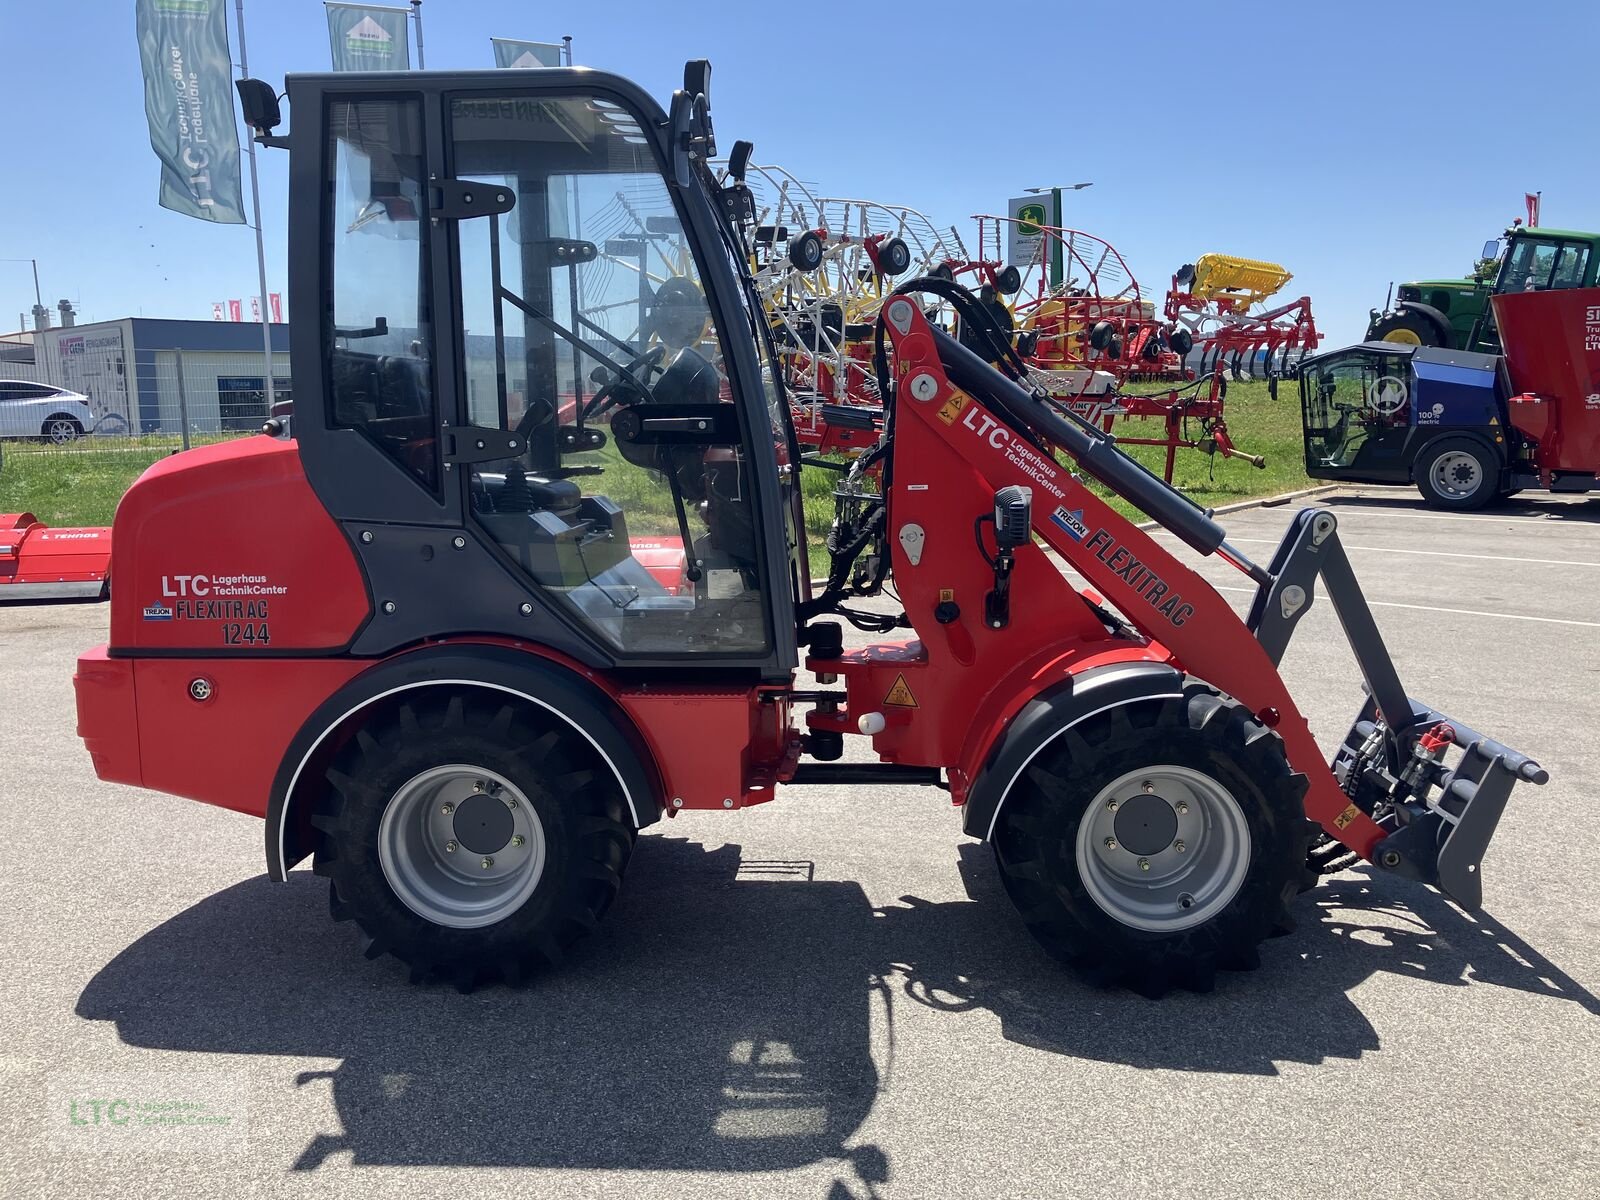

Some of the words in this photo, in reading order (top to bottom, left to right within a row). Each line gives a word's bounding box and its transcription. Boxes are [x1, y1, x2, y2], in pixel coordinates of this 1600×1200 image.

[962, 406, 1010, 449] LTC
[1010, 438, 1057, 479] Lagerhaus
[1004, 447, 1066, 499] TechnikCenter
[1057, 508, 1086, 537] TREJON
[162, 574, 210, 597] LTC
[212, 574, 267, 586] Lagerhaus
[212, 585, 288, 596] TechnikCenter
[1084, 527, 1195, 628] FLEXITRAC
[176, 599, 268, 620] FLEXITRAC
[222, 622, 270, 646] 1244
